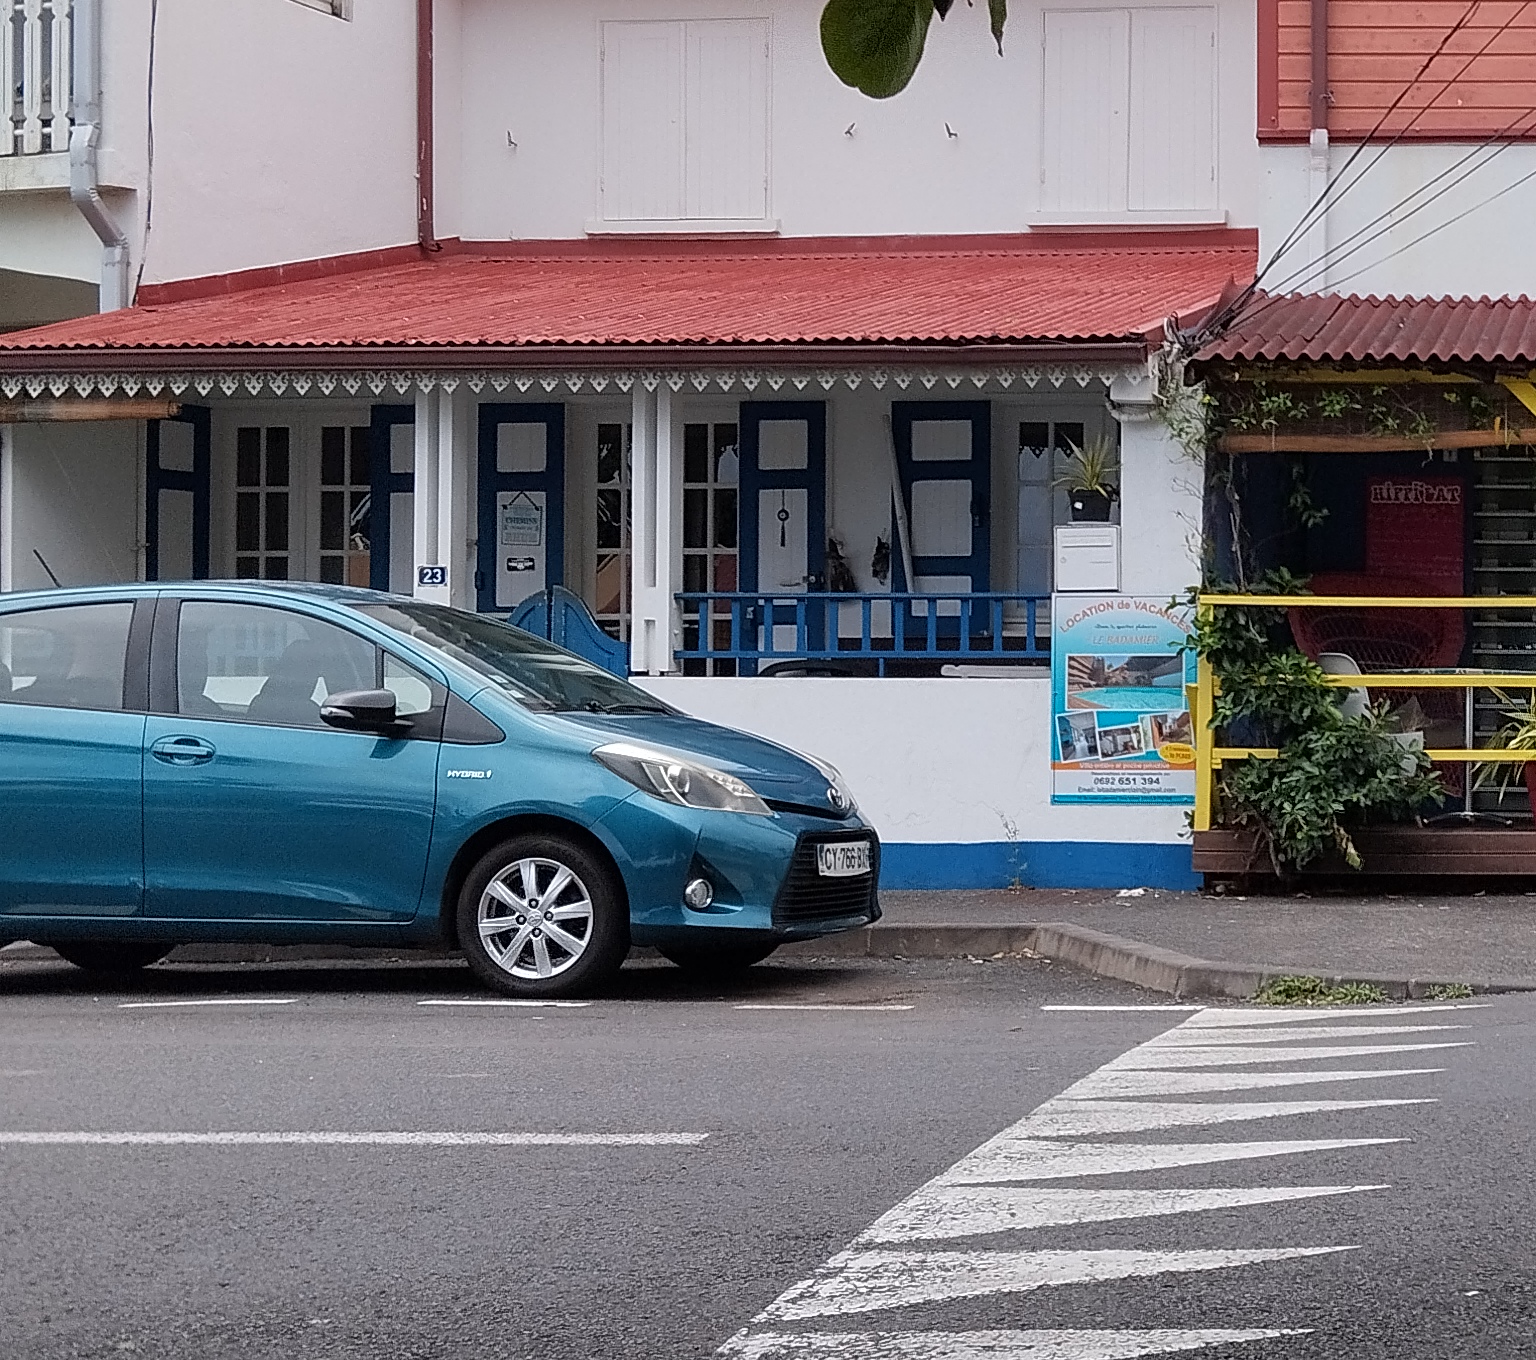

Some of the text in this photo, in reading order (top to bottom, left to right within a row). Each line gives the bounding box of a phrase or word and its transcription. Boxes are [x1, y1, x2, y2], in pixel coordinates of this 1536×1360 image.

[422, 569, 442, 583] 23
[1060, 600, 1192, 634] LOCATION de VACANCES
[1092, 635, 1102, 645] LE
[1093, 777, 1160, 785] 0692 651 394
